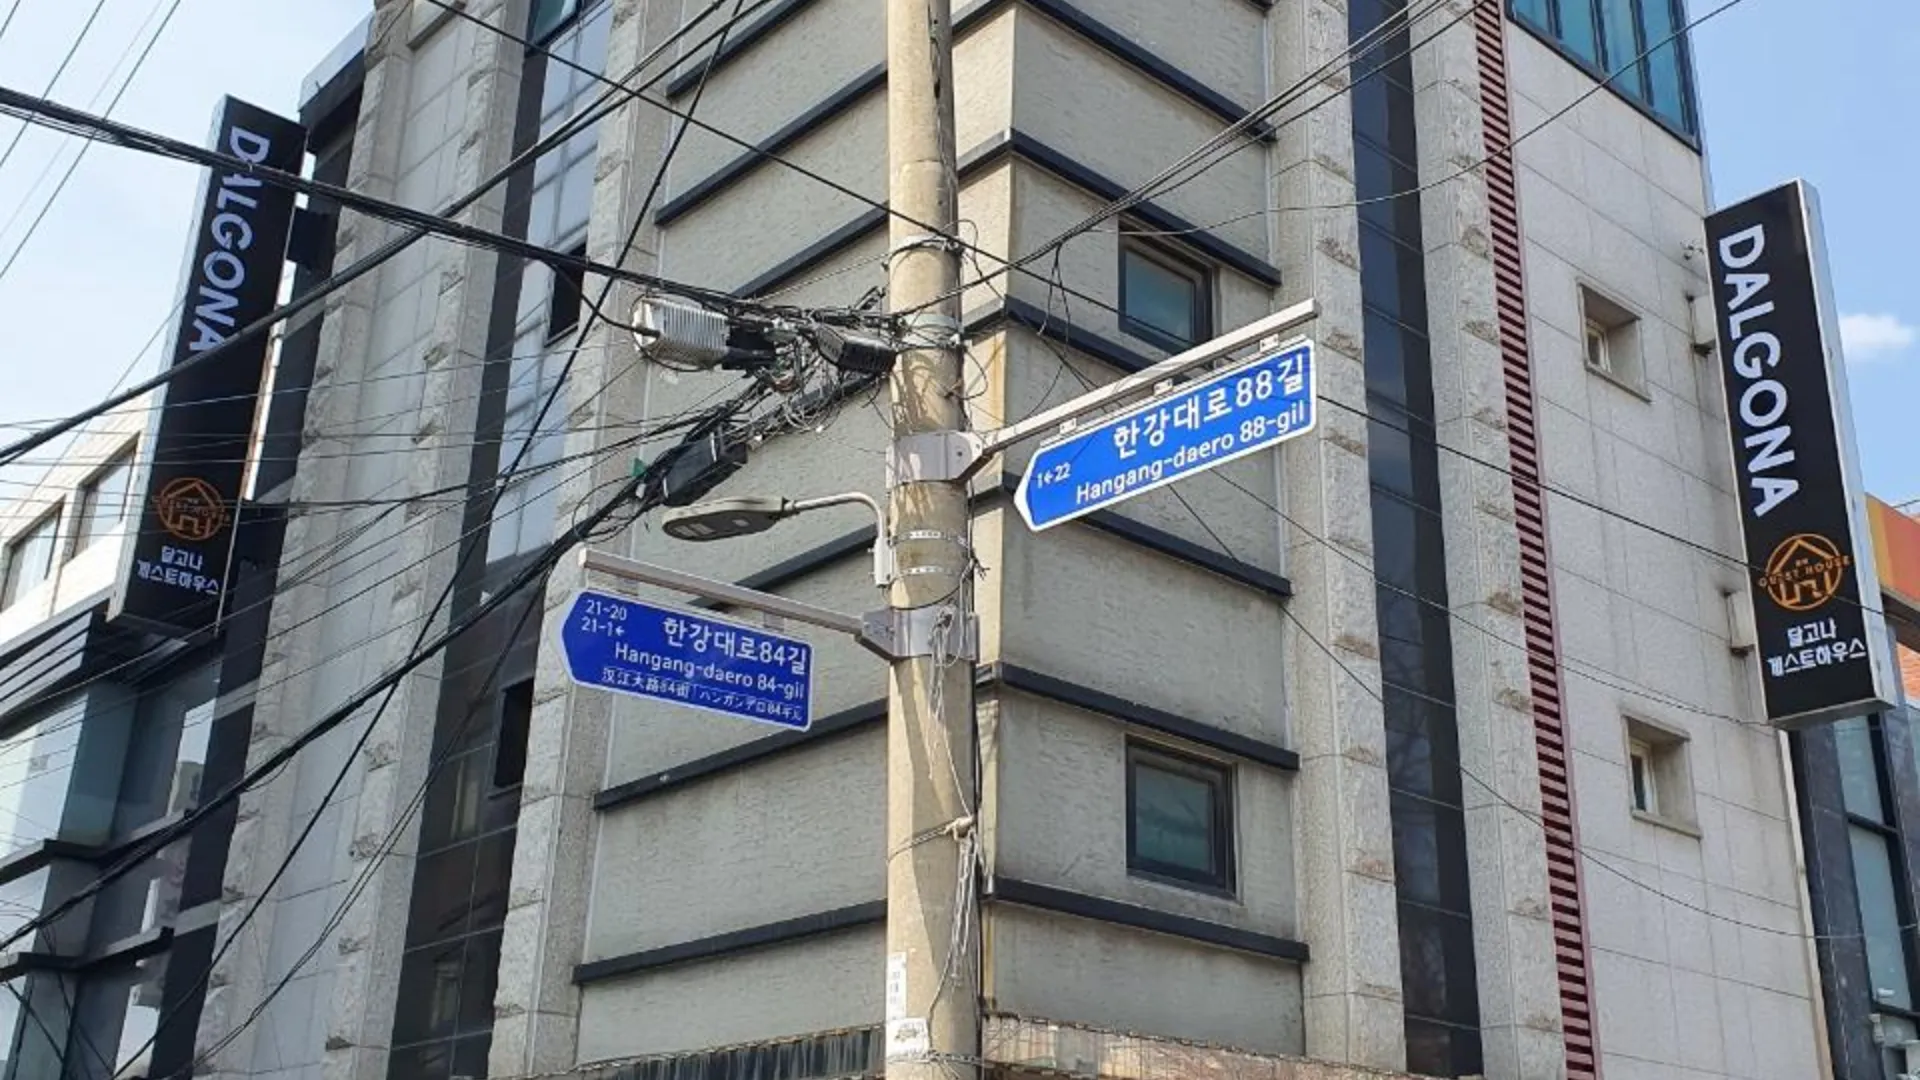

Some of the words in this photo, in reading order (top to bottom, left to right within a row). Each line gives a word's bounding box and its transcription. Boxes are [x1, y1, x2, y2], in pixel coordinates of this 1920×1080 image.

[1718, 223, 1800, 517] DALGONA
[1113, 354, 1304, 460] 한강대로88길
[1076, 433, 1234, 504] Hangang-daero
[1240, 401, 1304, 443] 88-gil
[138, 559, 219, 595] 게스트하우스
[161, 545, 203, 570] 달고나
[581, 616, 613, 637] 21-1
[585, 599, 628, 621] 21-20
[663, 617, 806, 675] 한강대로84길
[1787, 617, 1837, 648] 달고나
[615, 641, 753, 688] Hangang-daero
[757, 675, 805, 700] 84-gil
[1767, 637, 1867, 677] 게스트하우스
